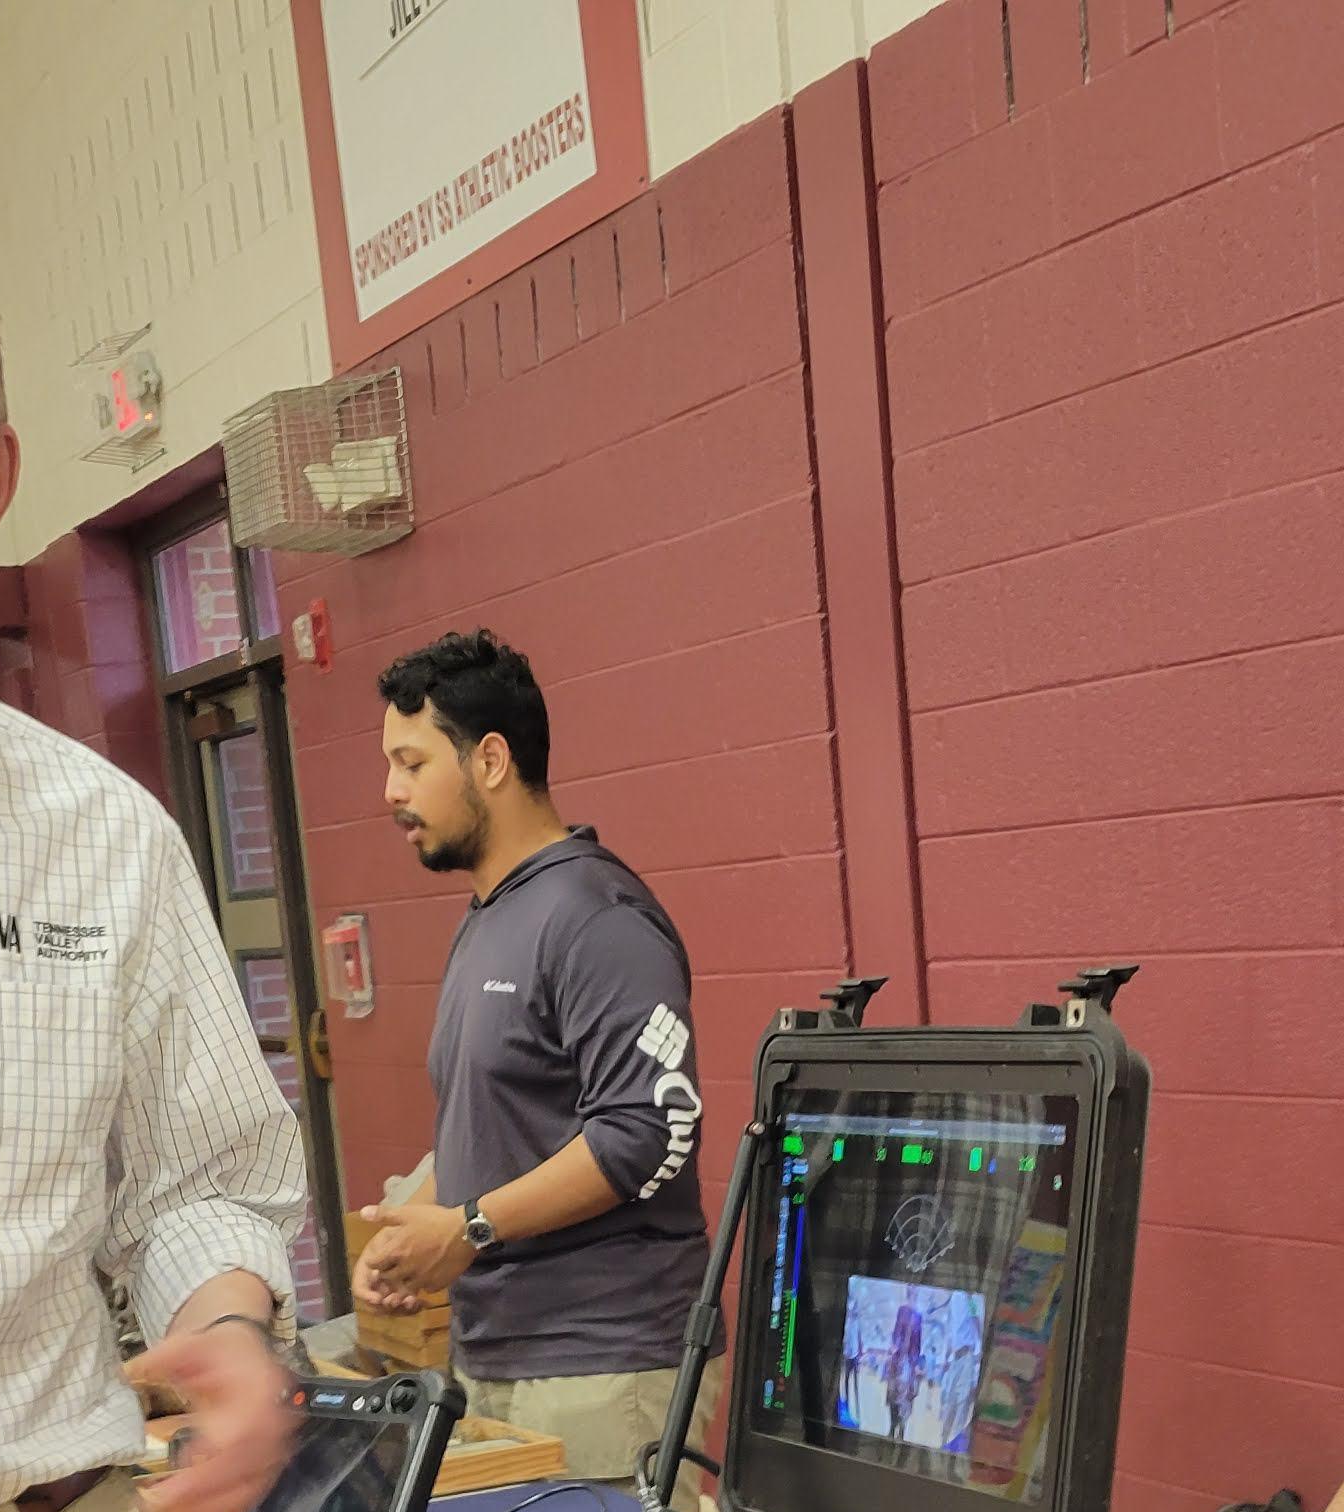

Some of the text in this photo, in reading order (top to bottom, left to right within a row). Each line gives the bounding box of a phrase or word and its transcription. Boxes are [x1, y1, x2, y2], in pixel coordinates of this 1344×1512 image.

[355, 92, 587, 289] SPONSORED BY SS ATHLETIC BOOSTERS
[32, 921, 107, 938] TENNESSEE
[34, 934, 82, 949] VALLEY
[36, 947, 109, 963] AUTHORITY
